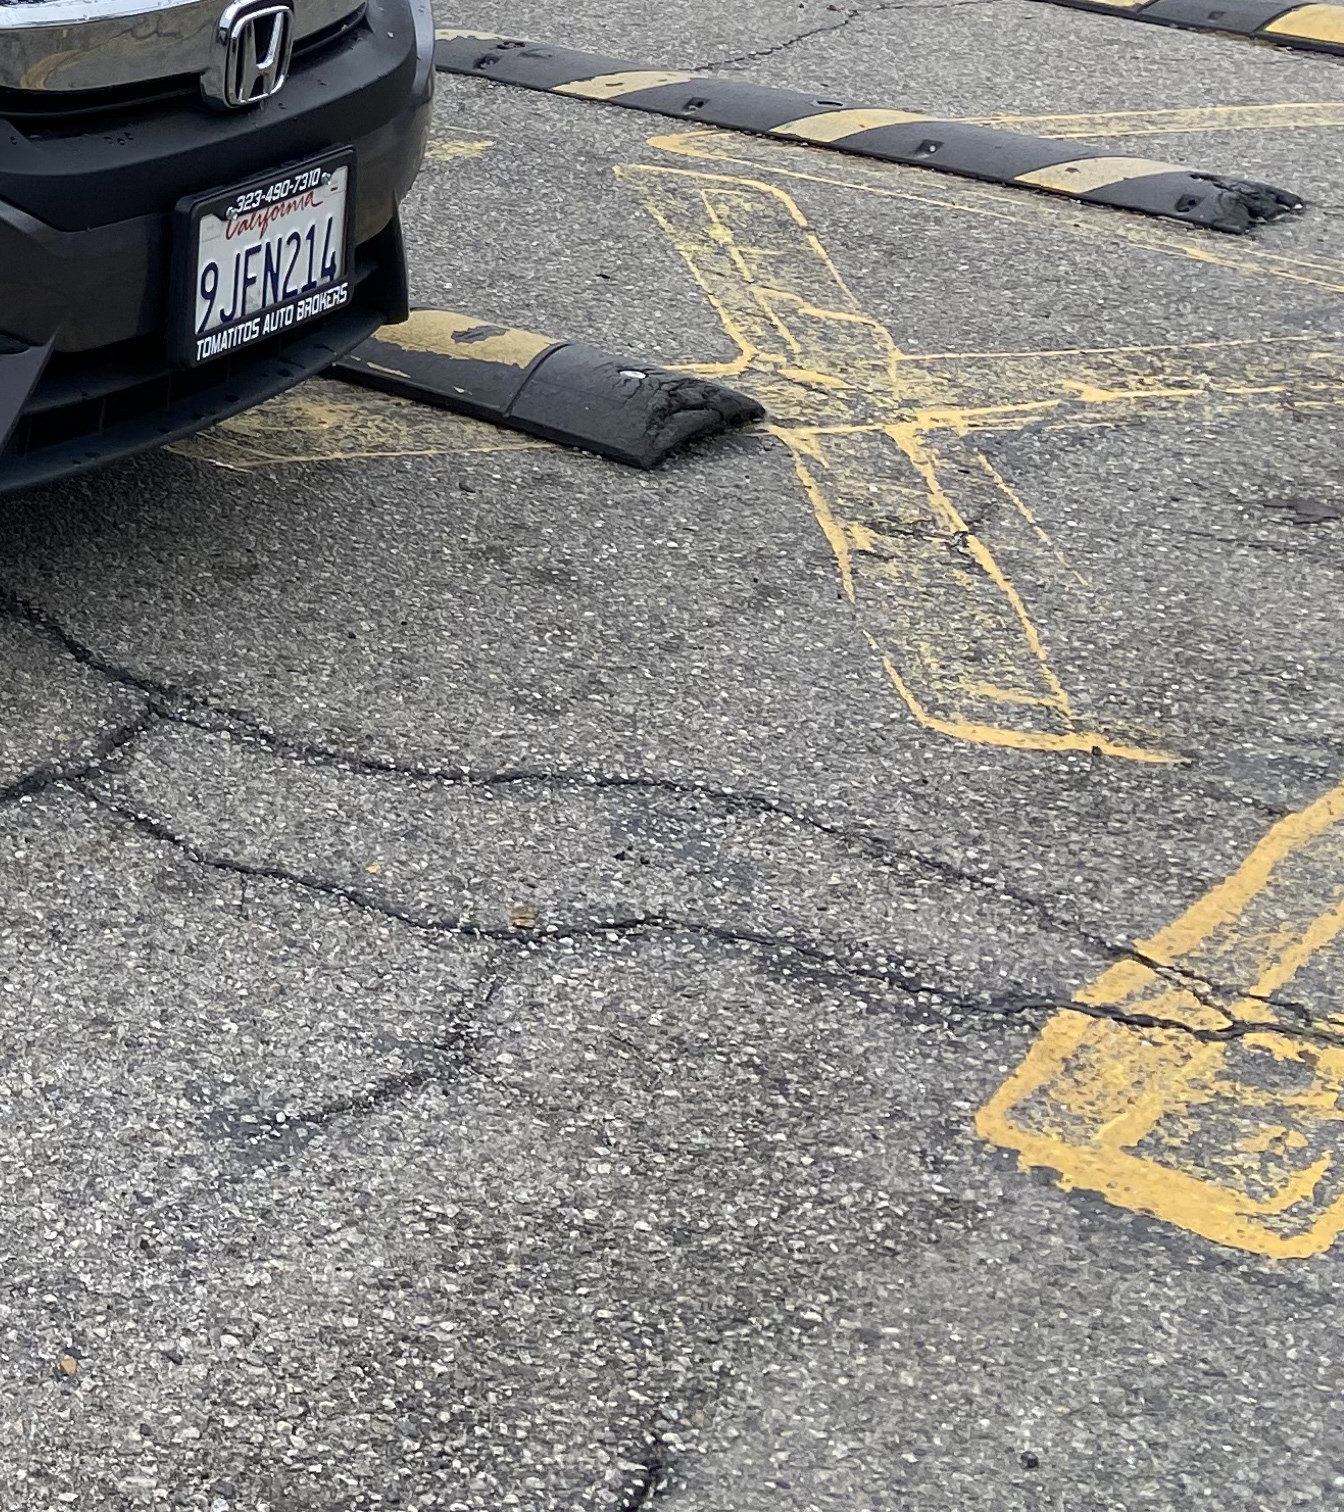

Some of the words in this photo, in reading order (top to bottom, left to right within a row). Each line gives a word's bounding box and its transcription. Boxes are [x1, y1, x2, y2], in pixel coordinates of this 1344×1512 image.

[225, 190, 324, 240] California
[236, 168, 322, 214] 323-490-7310
[195, 216, 337, 335] 9JFN214
[196, 317, 261, 361] TOMATITOS
[262, 303, 294, 336] AUTO
[296, 282, 349, 321] BROKERS
